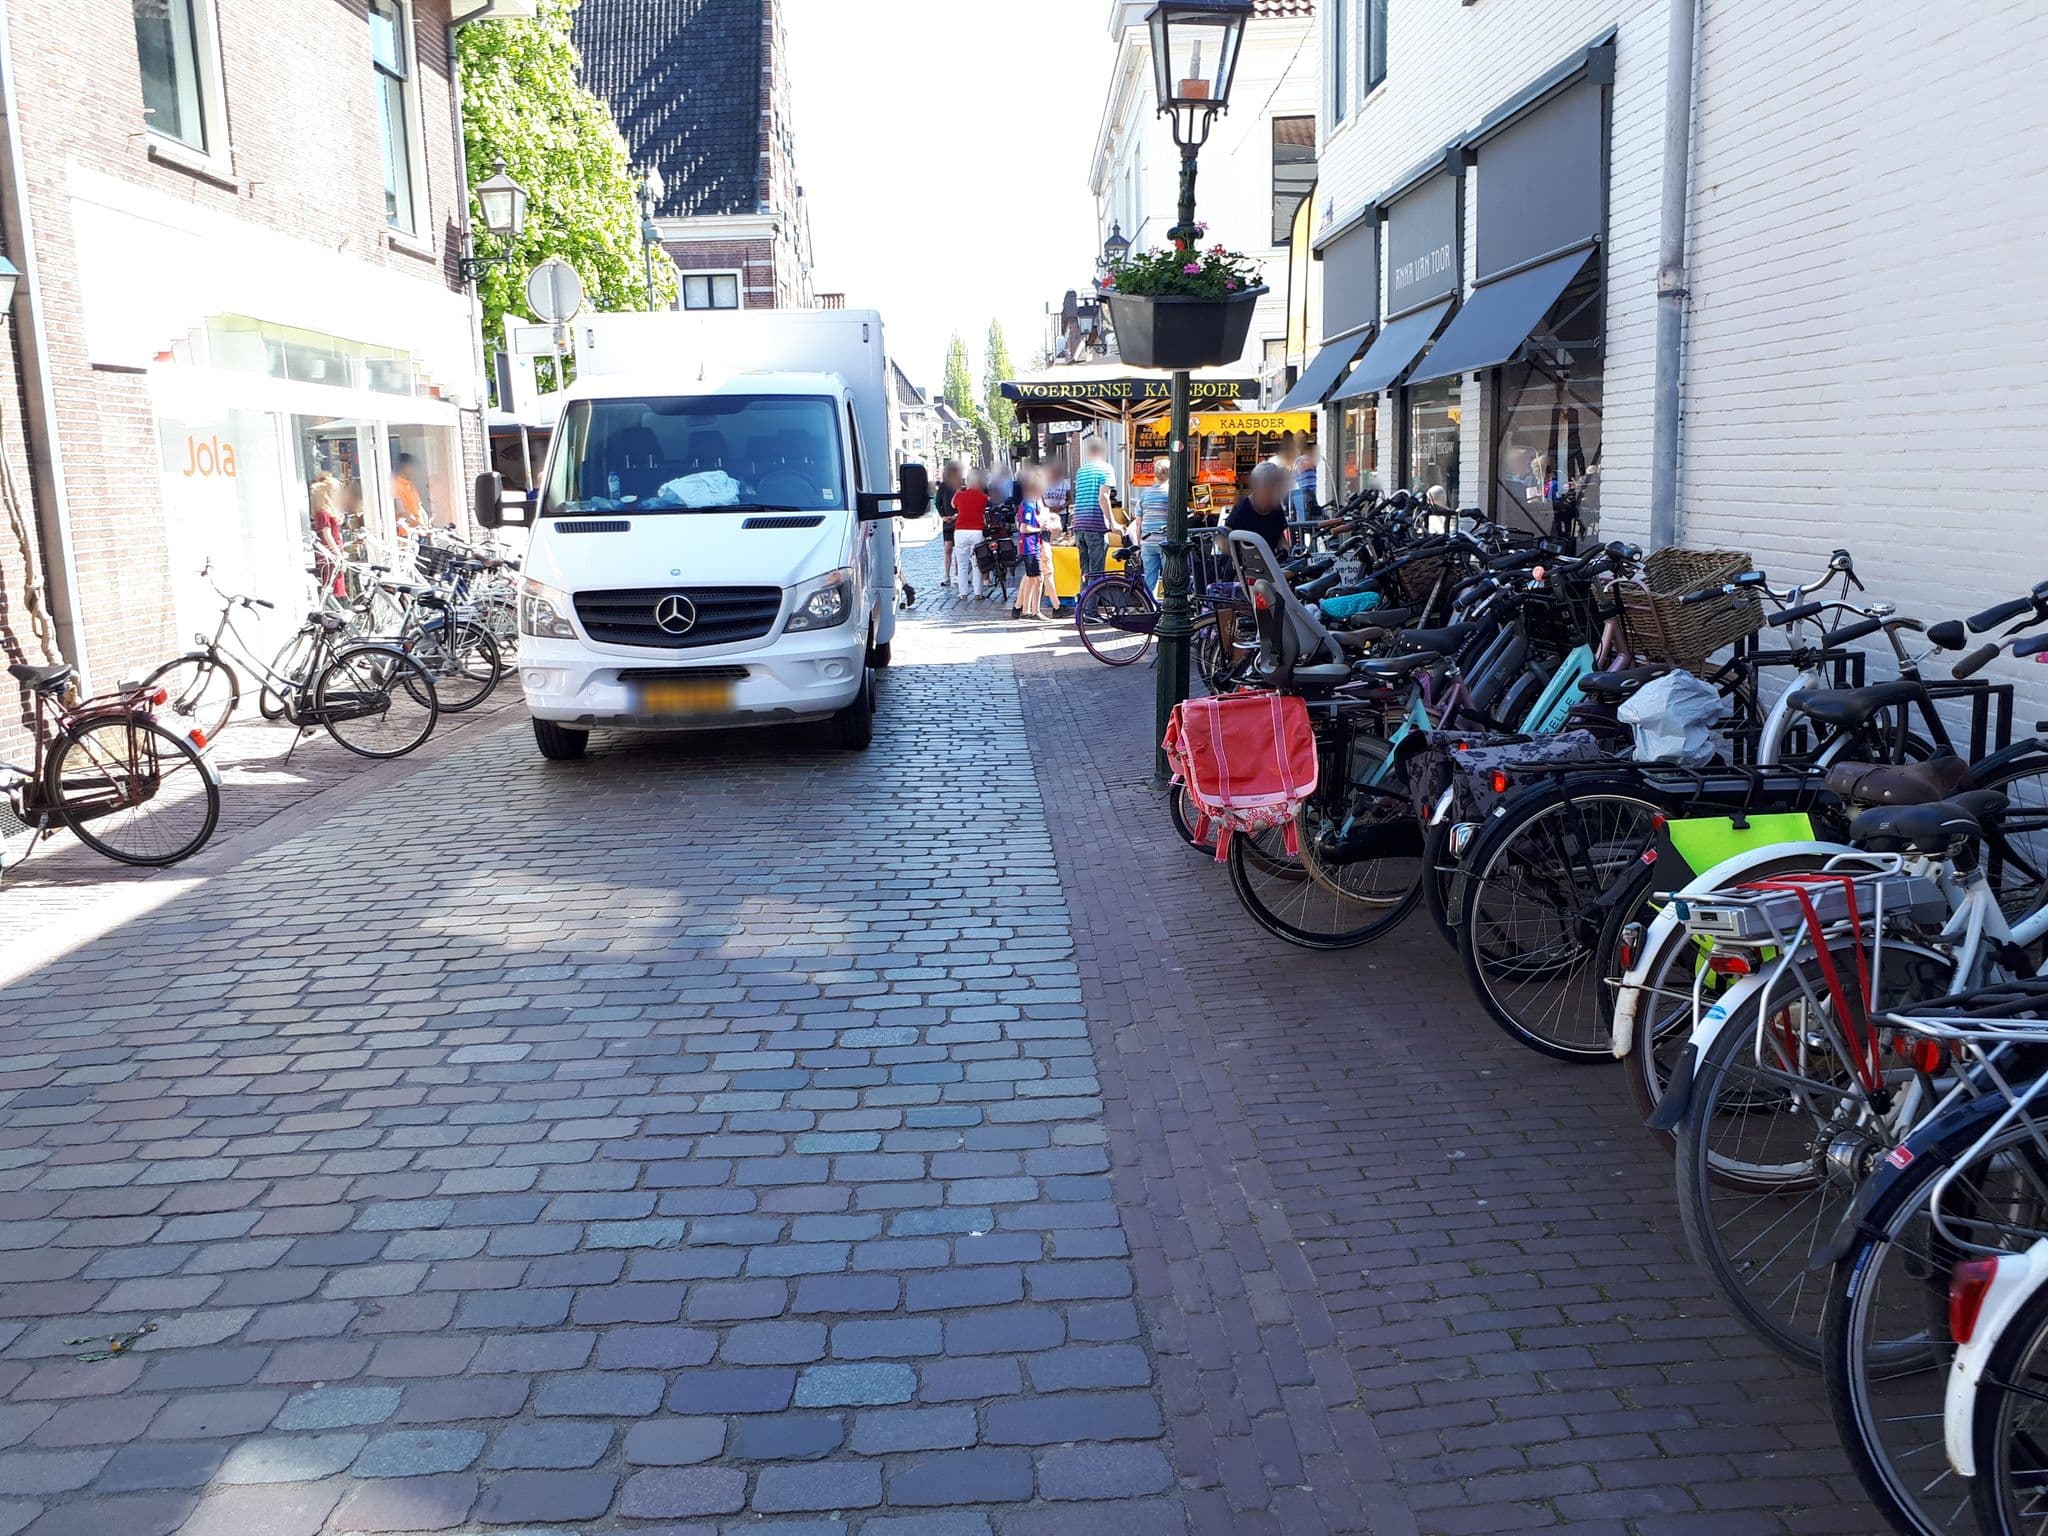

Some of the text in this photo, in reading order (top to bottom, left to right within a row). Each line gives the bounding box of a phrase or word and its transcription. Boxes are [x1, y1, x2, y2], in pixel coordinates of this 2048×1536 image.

[1016, 383, 1241, 397] WOERDENSE KABOER
[1220, 418, 1285, 429] KAASBOER
[183, 435, 236, 477] Jola
